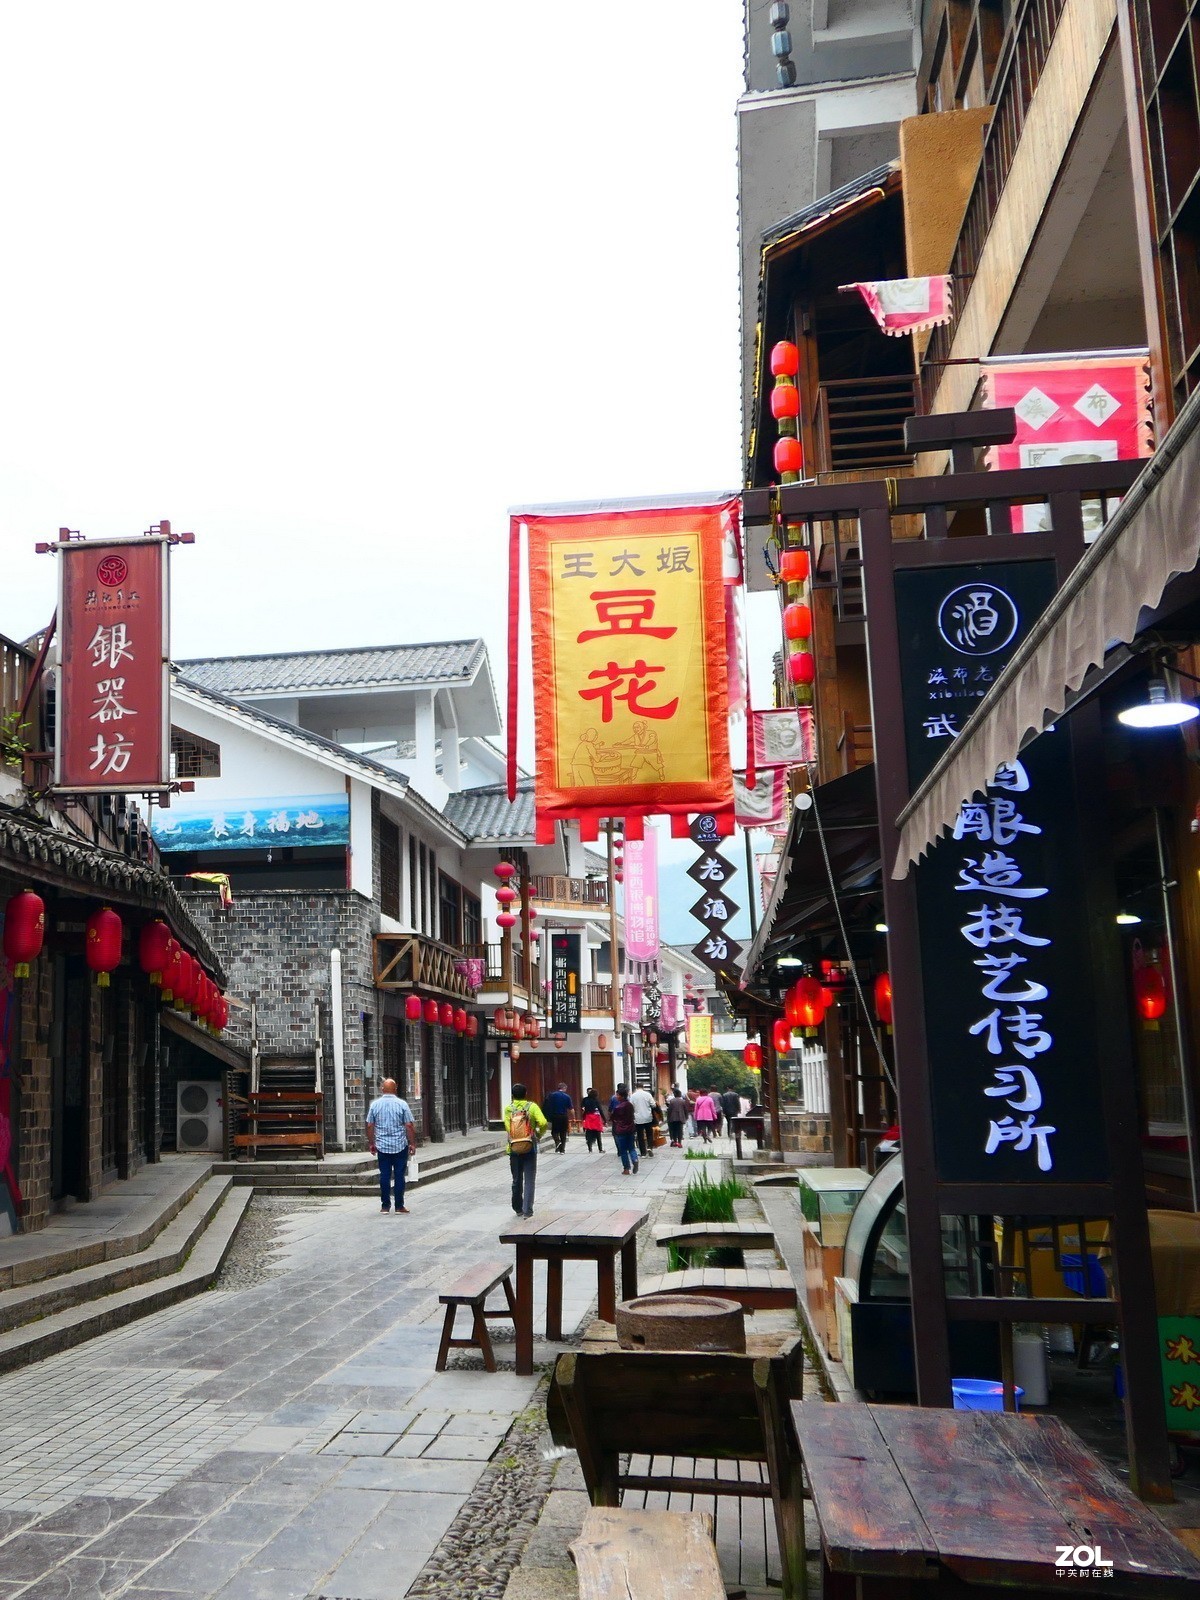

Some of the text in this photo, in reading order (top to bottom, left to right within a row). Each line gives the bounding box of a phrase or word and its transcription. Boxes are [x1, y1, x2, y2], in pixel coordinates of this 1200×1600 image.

[560, 545, 695, 579] 王大娘
[87, 622, 138, 777] 銀器坊
[577, 588, 680, 724] 豆花
[699, 856, 729, 961] 老酒坊
